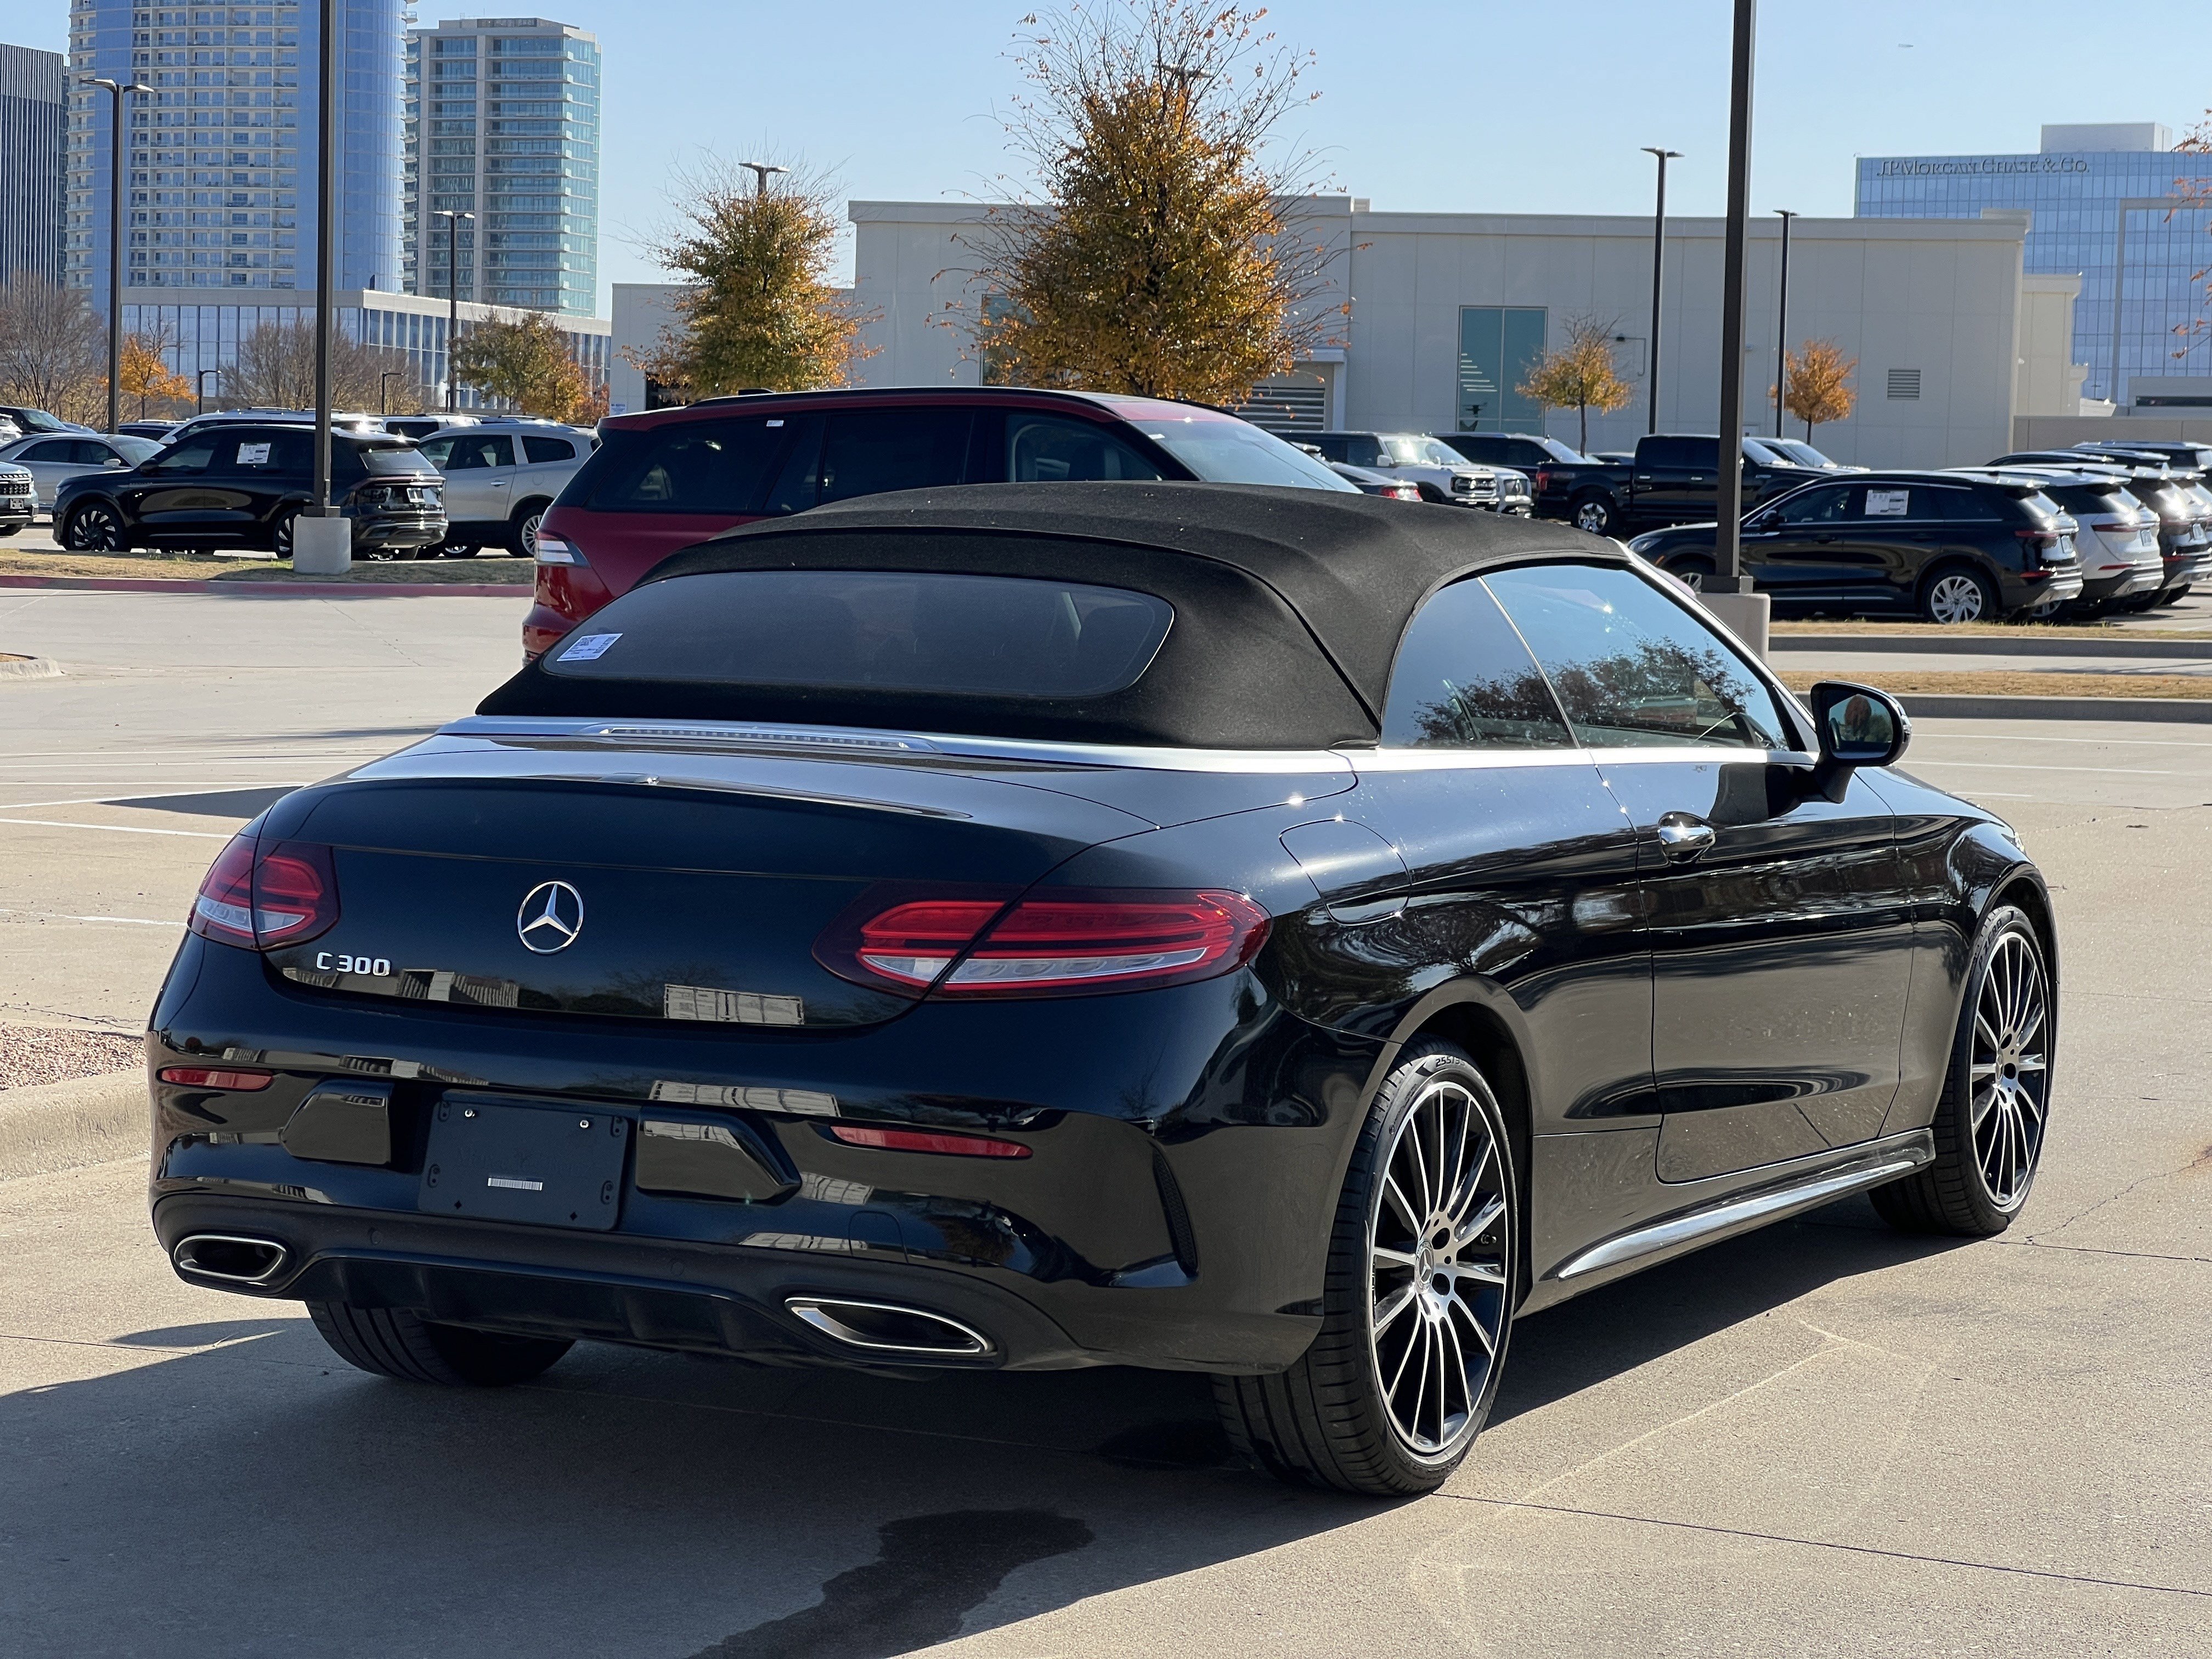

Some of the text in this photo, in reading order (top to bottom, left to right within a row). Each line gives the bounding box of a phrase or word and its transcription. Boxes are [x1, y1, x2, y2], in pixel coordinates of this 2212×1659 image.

[2042, 157, 2061, 173] &
[1983, 918, 2002, 955] ZERO
[316, 951, 391, 977] C 300
